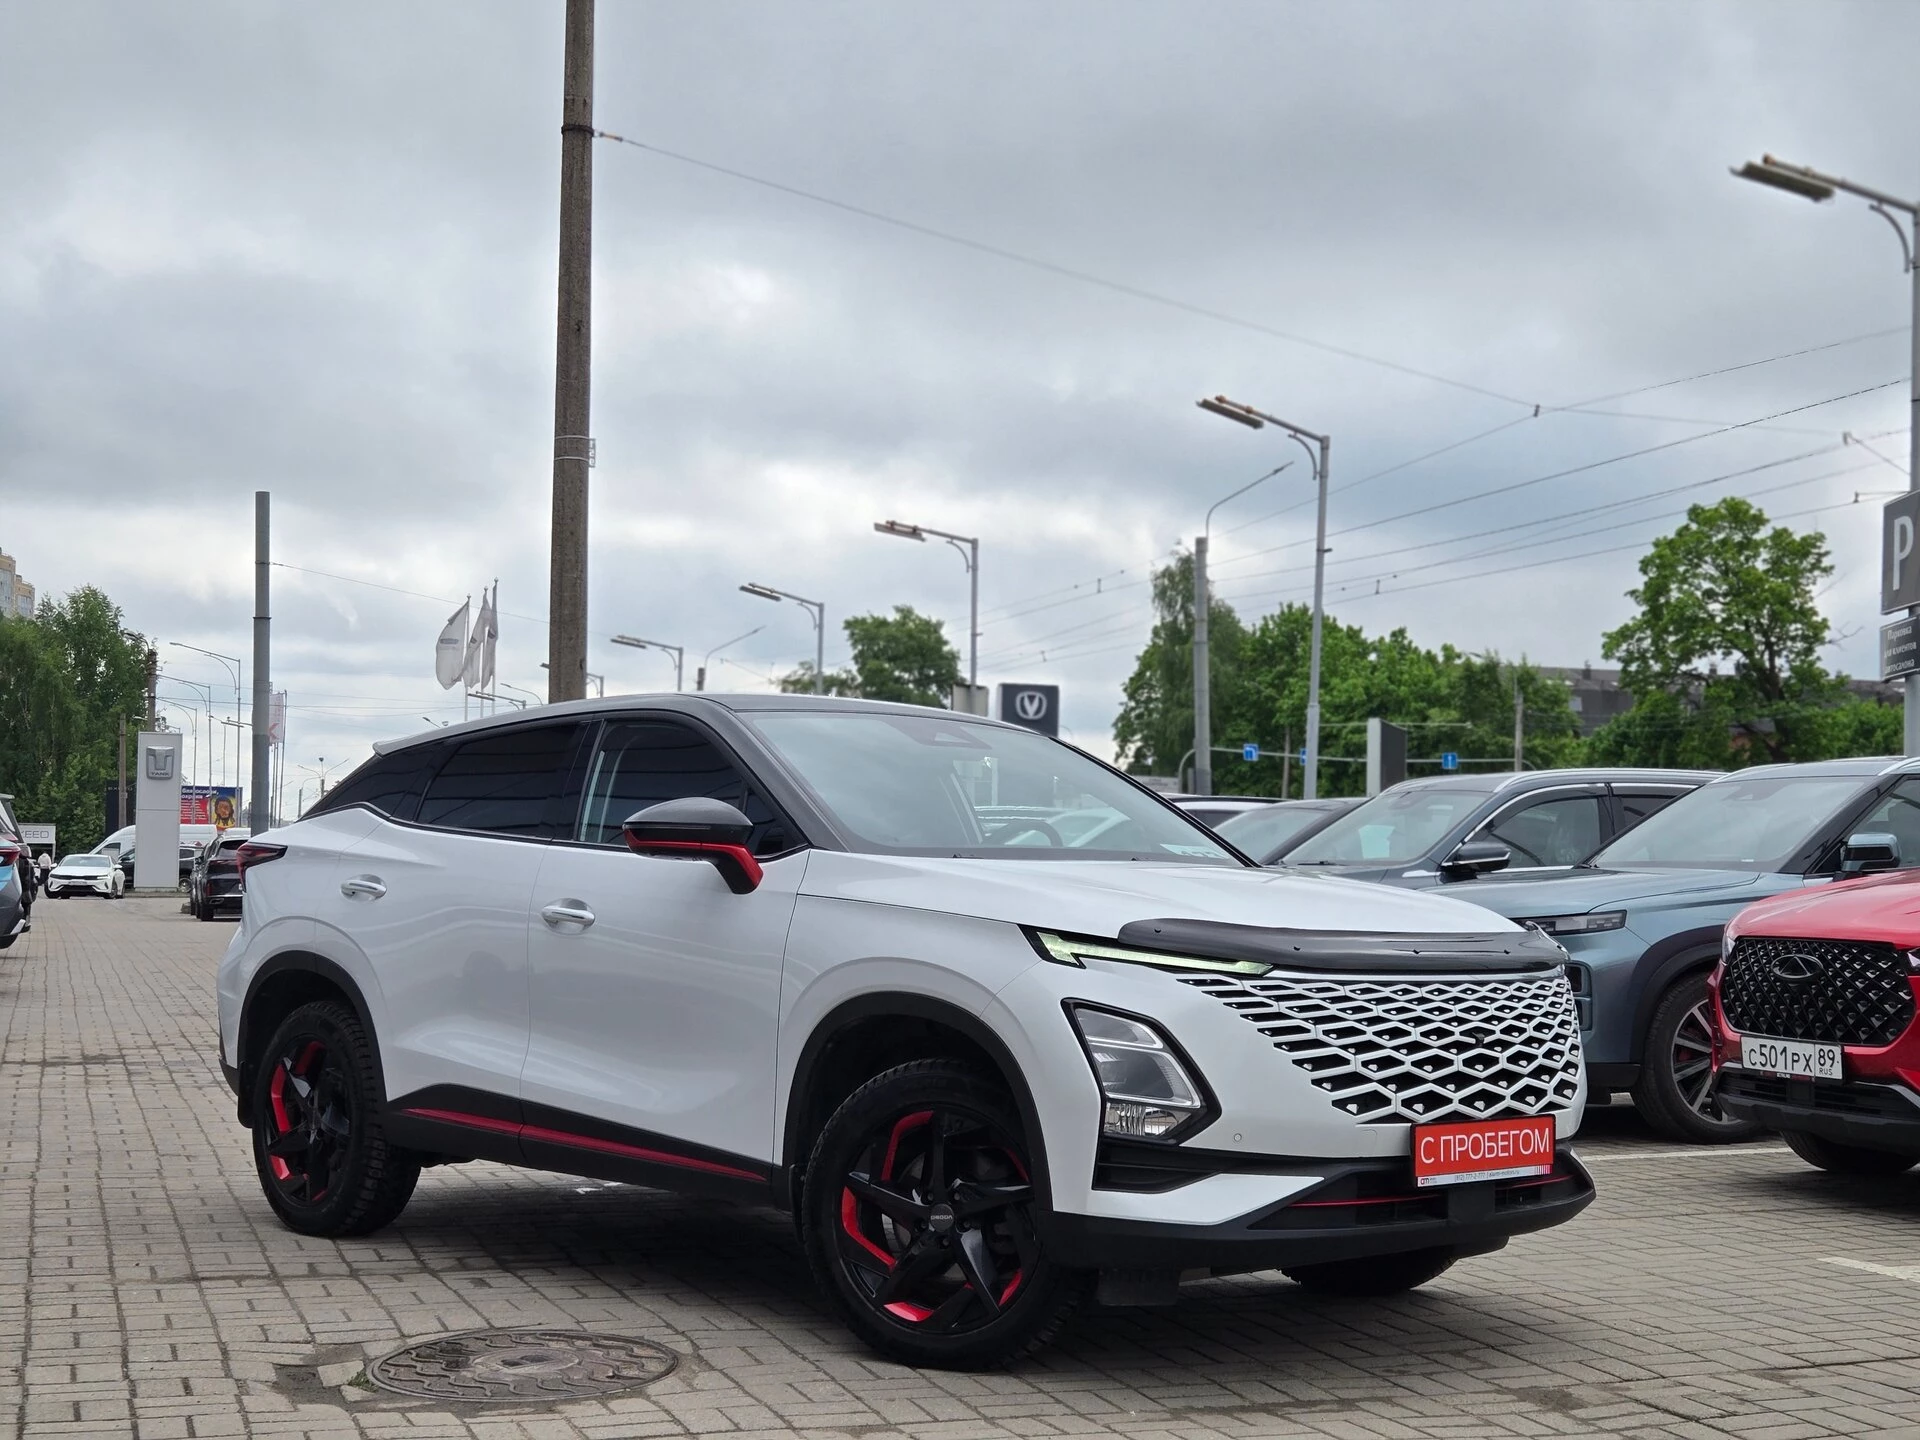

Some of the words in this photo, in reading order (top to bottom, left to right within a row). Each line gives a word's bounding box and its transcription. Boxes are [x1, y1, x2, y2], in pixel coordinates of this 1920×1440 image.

[1893, 515, 1914, 591] P
[1887, 626, 1912, 641] Парковка
[1817, 1048, 1836, 1068] 89
[1819, 1068, 1833, 1076] RUS
[1420, 1136, 1435, 1164] С
[1440, 1127, 1549, 1162] ПРОБЕГОМ
